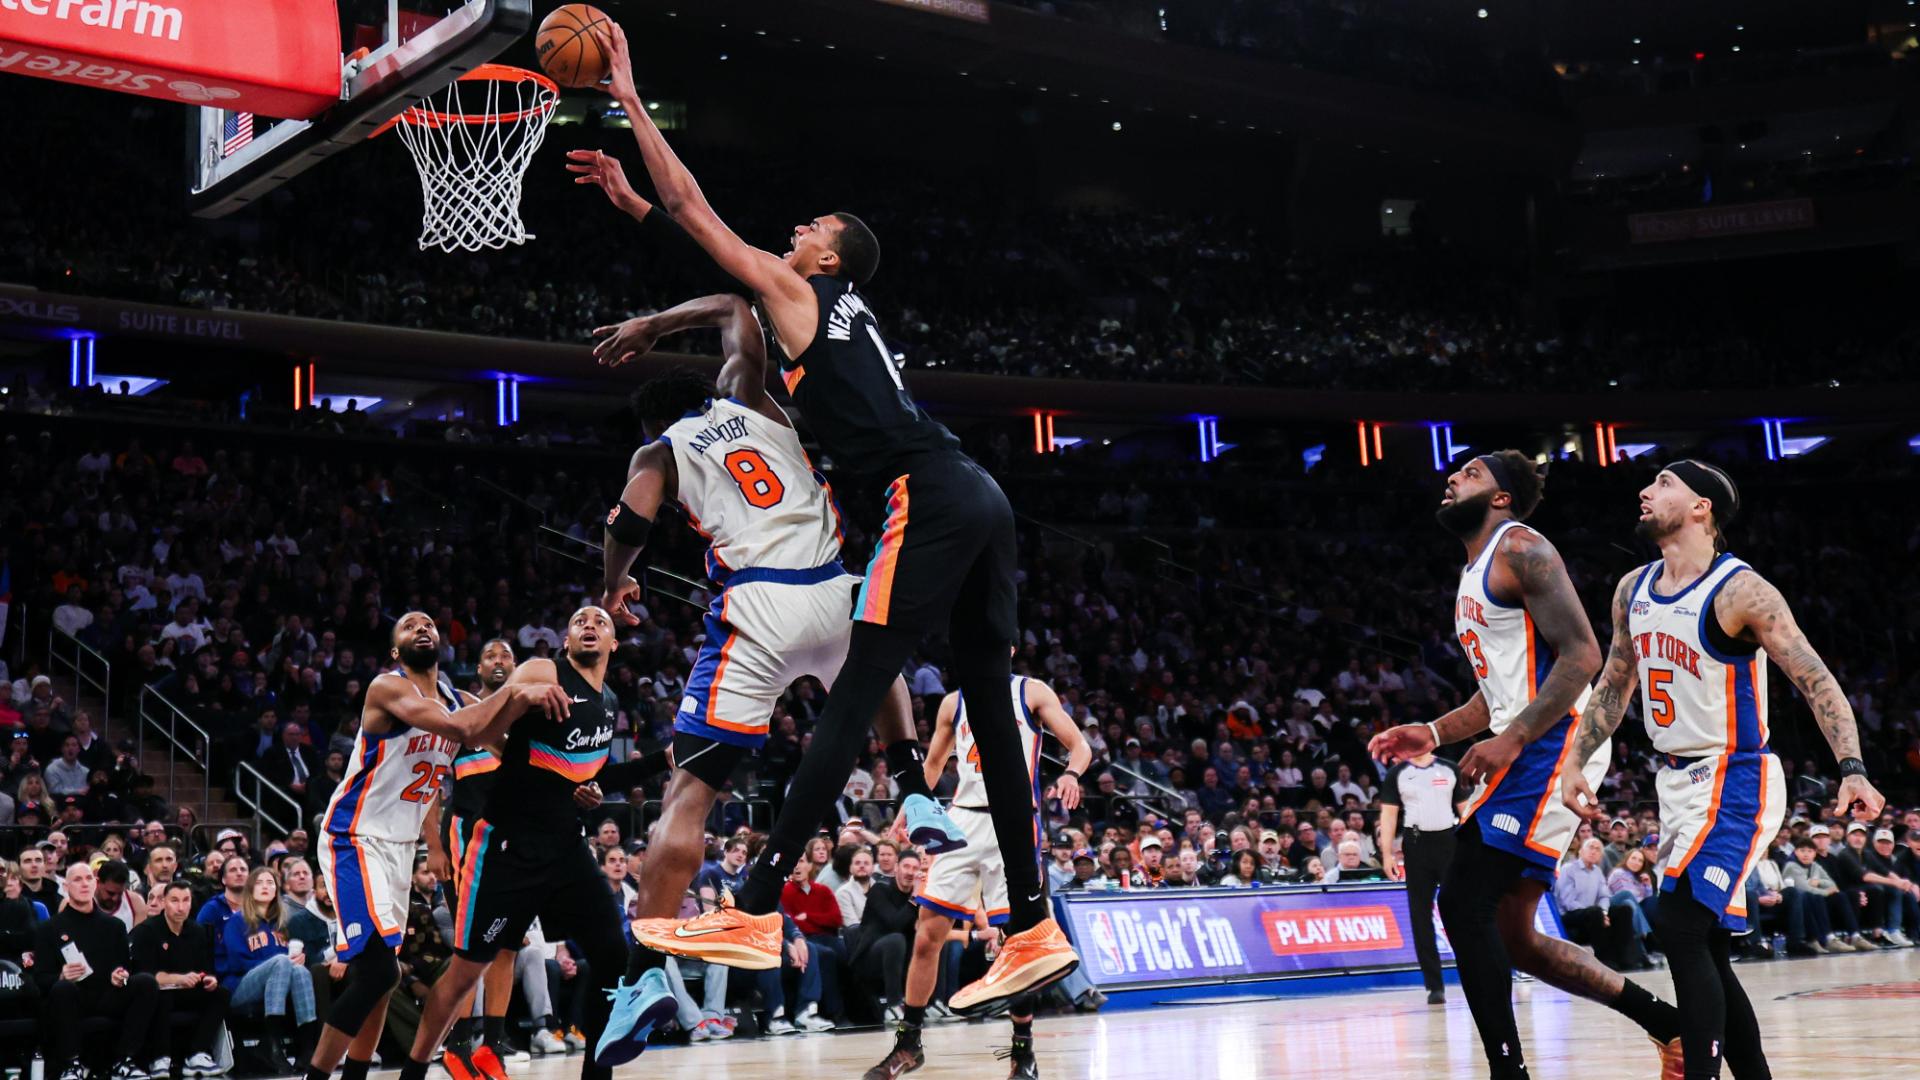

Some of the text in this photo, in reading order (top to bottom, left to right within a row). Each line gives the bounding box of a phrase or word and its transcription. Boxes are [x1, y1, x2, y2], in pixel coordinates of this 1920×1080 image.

[119, 311, 243, 339] SUITE LEVEL
[864, 322, 904, 390] 1
[724, 449, 785, 510] 8
[1656, 632, 1702, 681] YORK
[1648, 667, 1676, 728] 5
[565, 728, 591, 751] San
[400, 760, 449, 805] 25
[1112, 906, 1244, 973] Pick'Em
[1274, 914, 1388, 946] PLAY NOW
